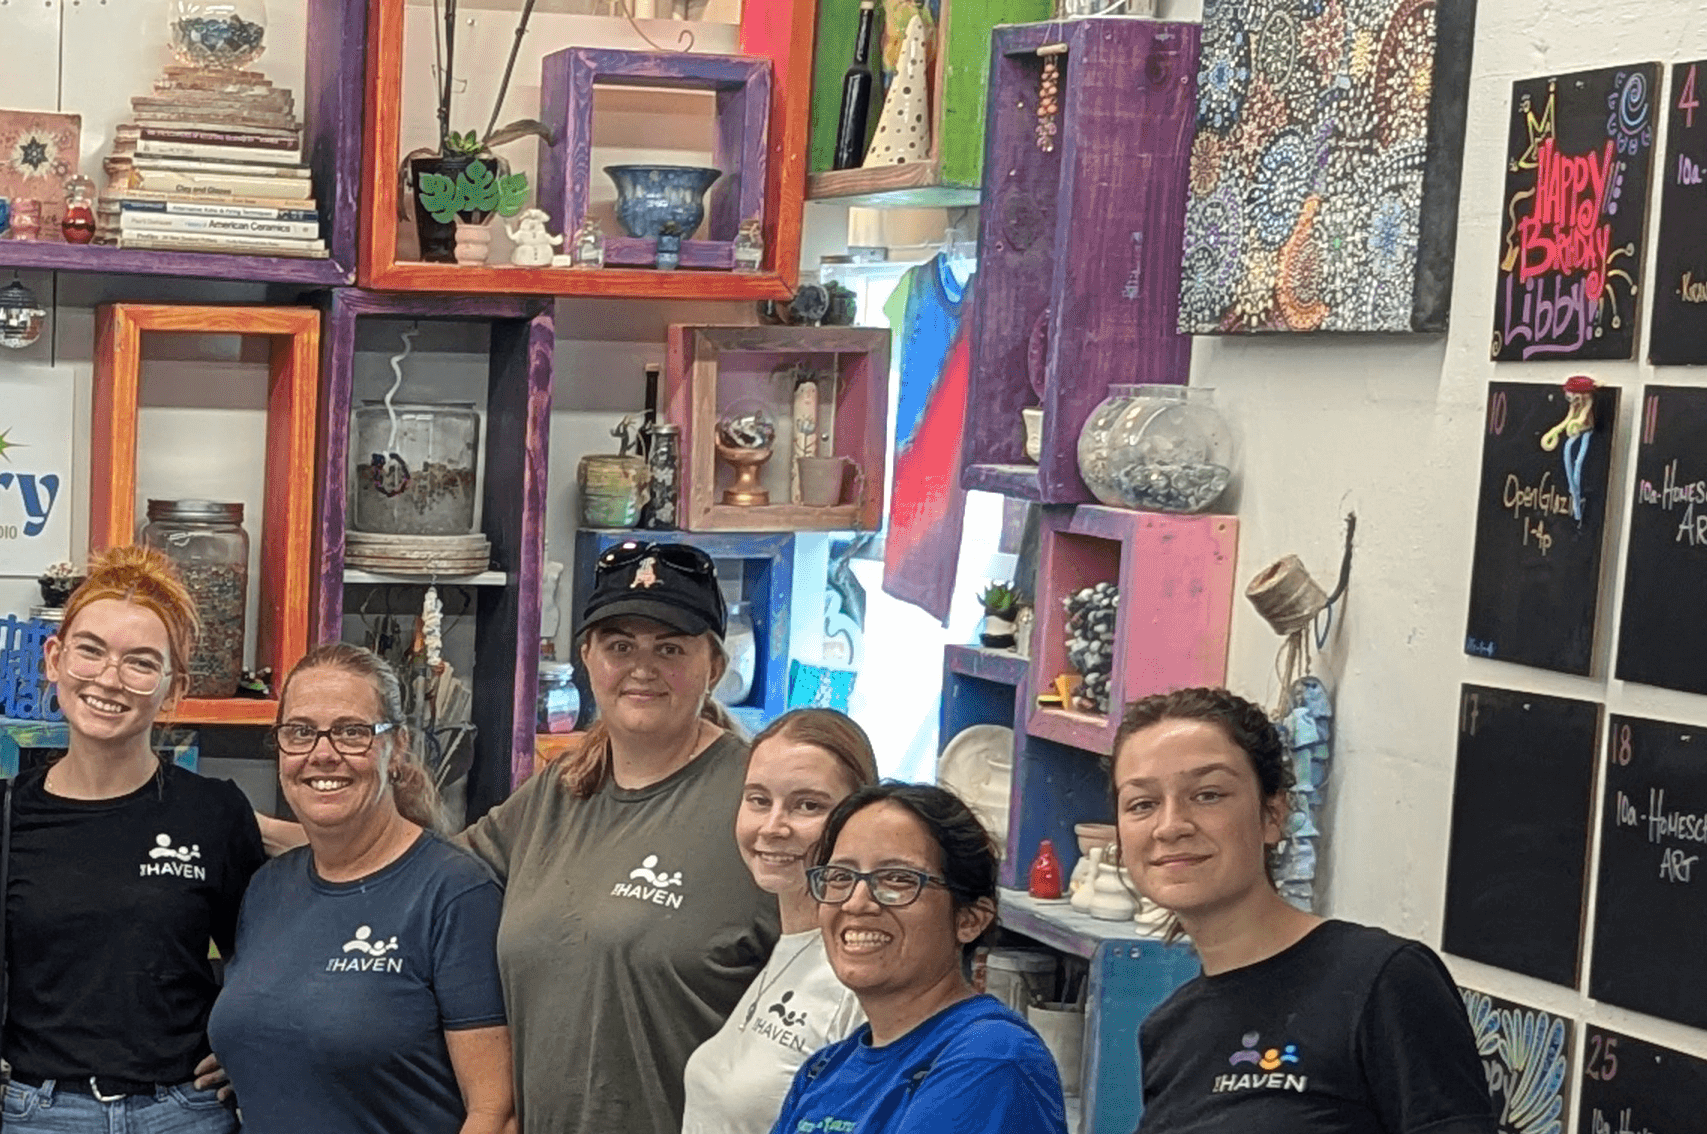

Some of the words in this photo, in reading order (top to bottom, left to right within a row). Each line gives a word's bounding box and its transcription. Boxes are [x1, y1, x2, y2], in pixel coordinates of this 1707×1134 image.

[1679, 63, 1699, 128] 4
[209, 220, 249, 231] American
[250, 222, 291, 232] Ceramics
[1490, 391, 1507, 435] 10
[1612, 724, 1632, 766] 18
[147, 861, 206, 881] HAVEN
[1659, 848, 1699, 883] ART
[617, 883, 684, 910] HAVEN
[332, 957, 403, 974] HAVEN
[757, 1018, 806, 1052] HAVEN
[1585, 1034, 1618, 1081] 25
[1219, 1072, 1308, 1093] HAVEN
